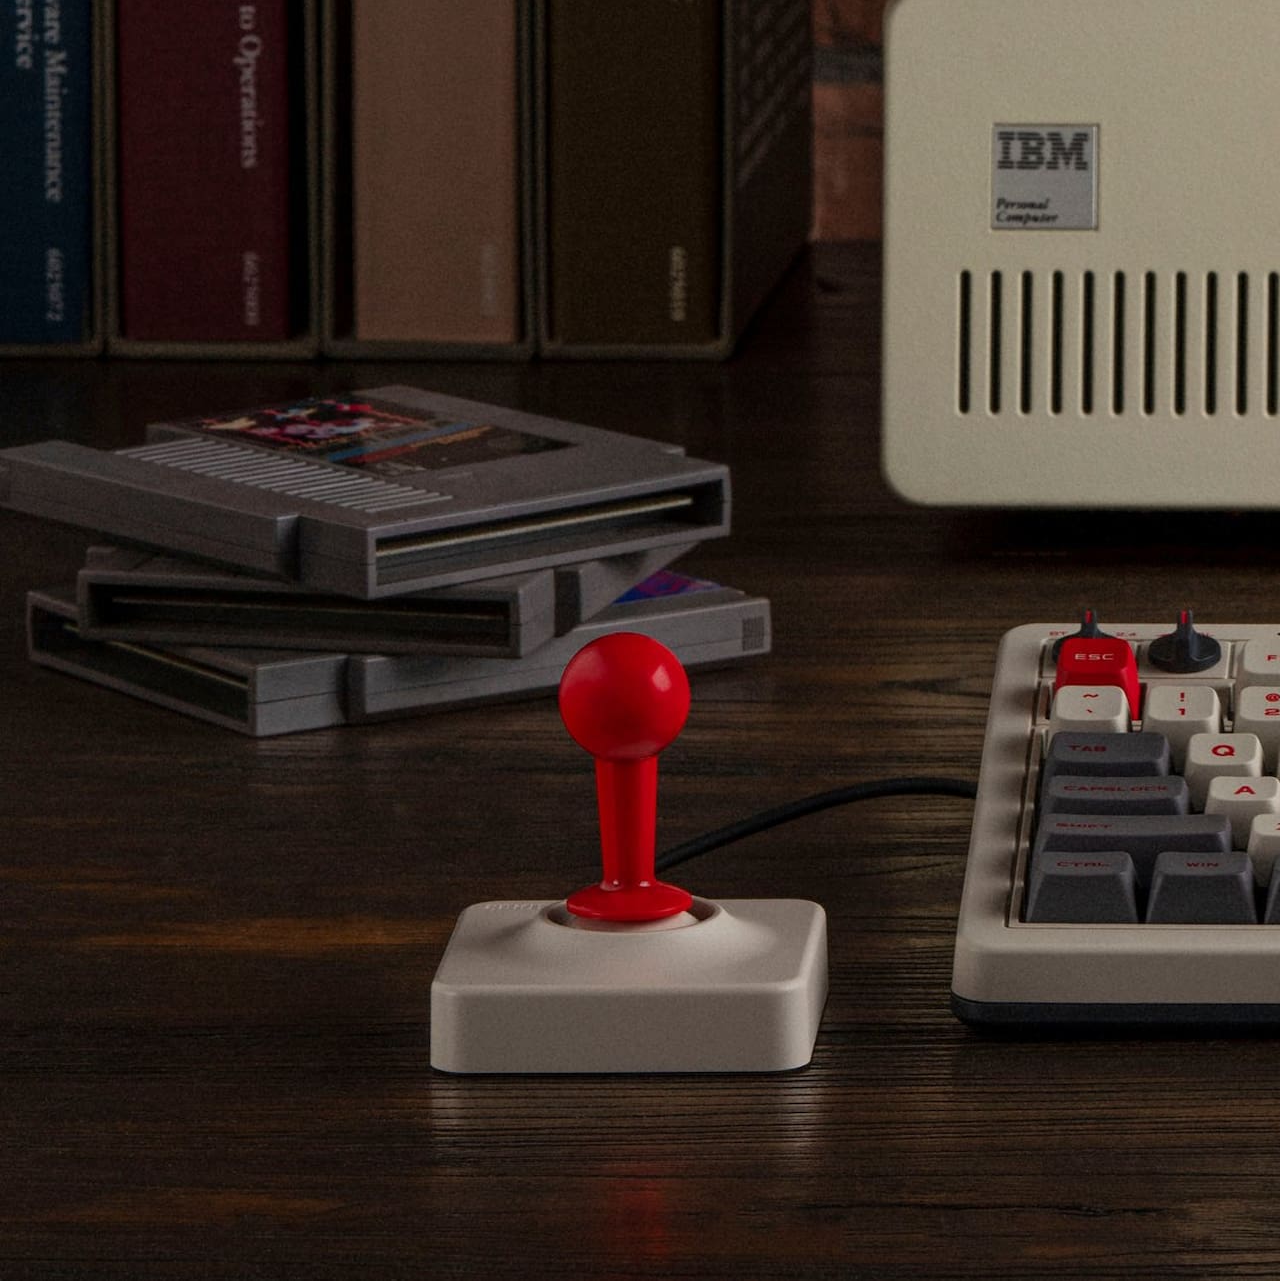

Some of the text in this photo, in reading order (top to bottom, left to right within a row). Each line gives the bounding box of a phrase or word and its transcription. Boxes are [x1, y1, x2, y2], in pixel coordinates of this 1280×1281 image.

[239, 5, 260, 30] to
[233, 35, 263, 169] Operations
[44, 49, 68, 203] Maintenance
[997, 131, 1088, 170] IBM
[1074, 653, 1115, 661] ESC
[1178, 708, 1186, 716] 1
[1264, 708, 1280, 716] 2
[1069, 744, 1108, 753] TAB
[1211, 744, 1235, 757] Q
[1234, 785, 1256, 796] A
